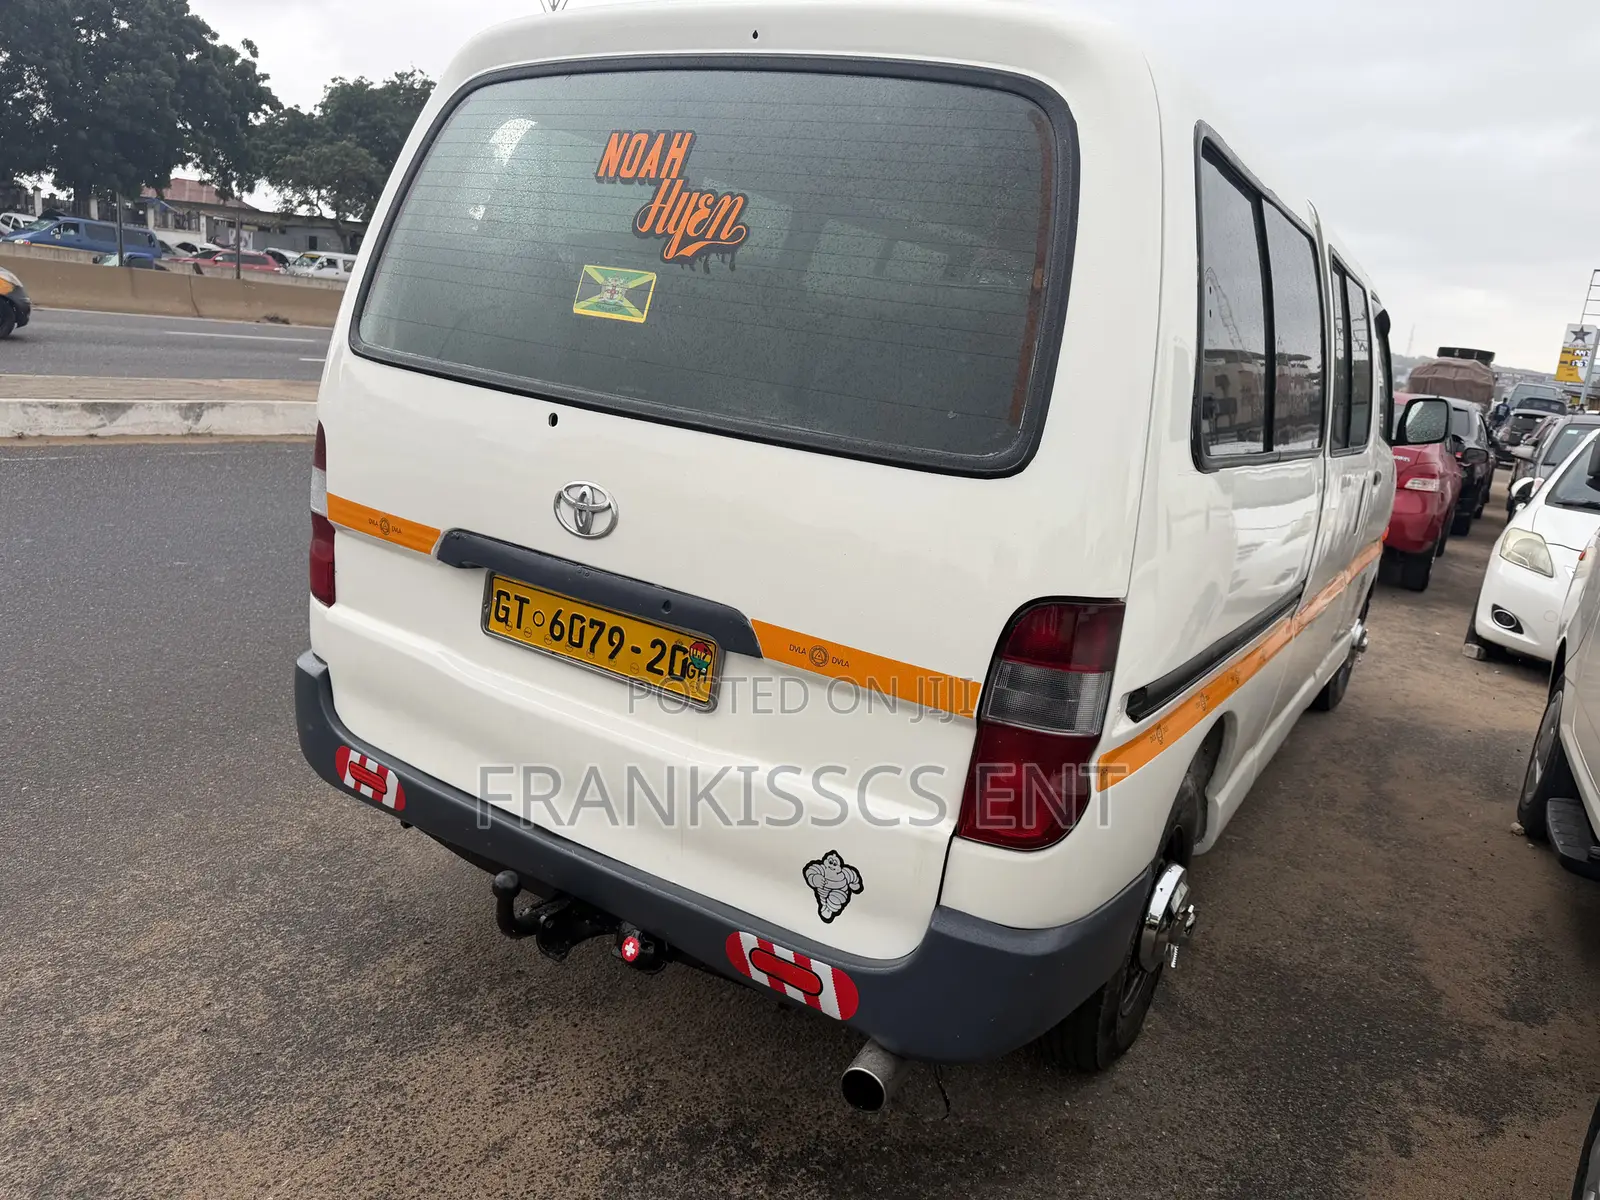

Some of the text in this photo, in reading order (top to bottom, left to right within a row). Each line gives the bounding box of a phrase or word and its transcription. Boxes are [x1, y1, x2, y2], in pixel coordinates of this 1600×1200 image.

[596, 131, 696, 182] NOAH
[494, 589, 531, 630] GT
[789, 643, 850, 668] DVLA DVLA
